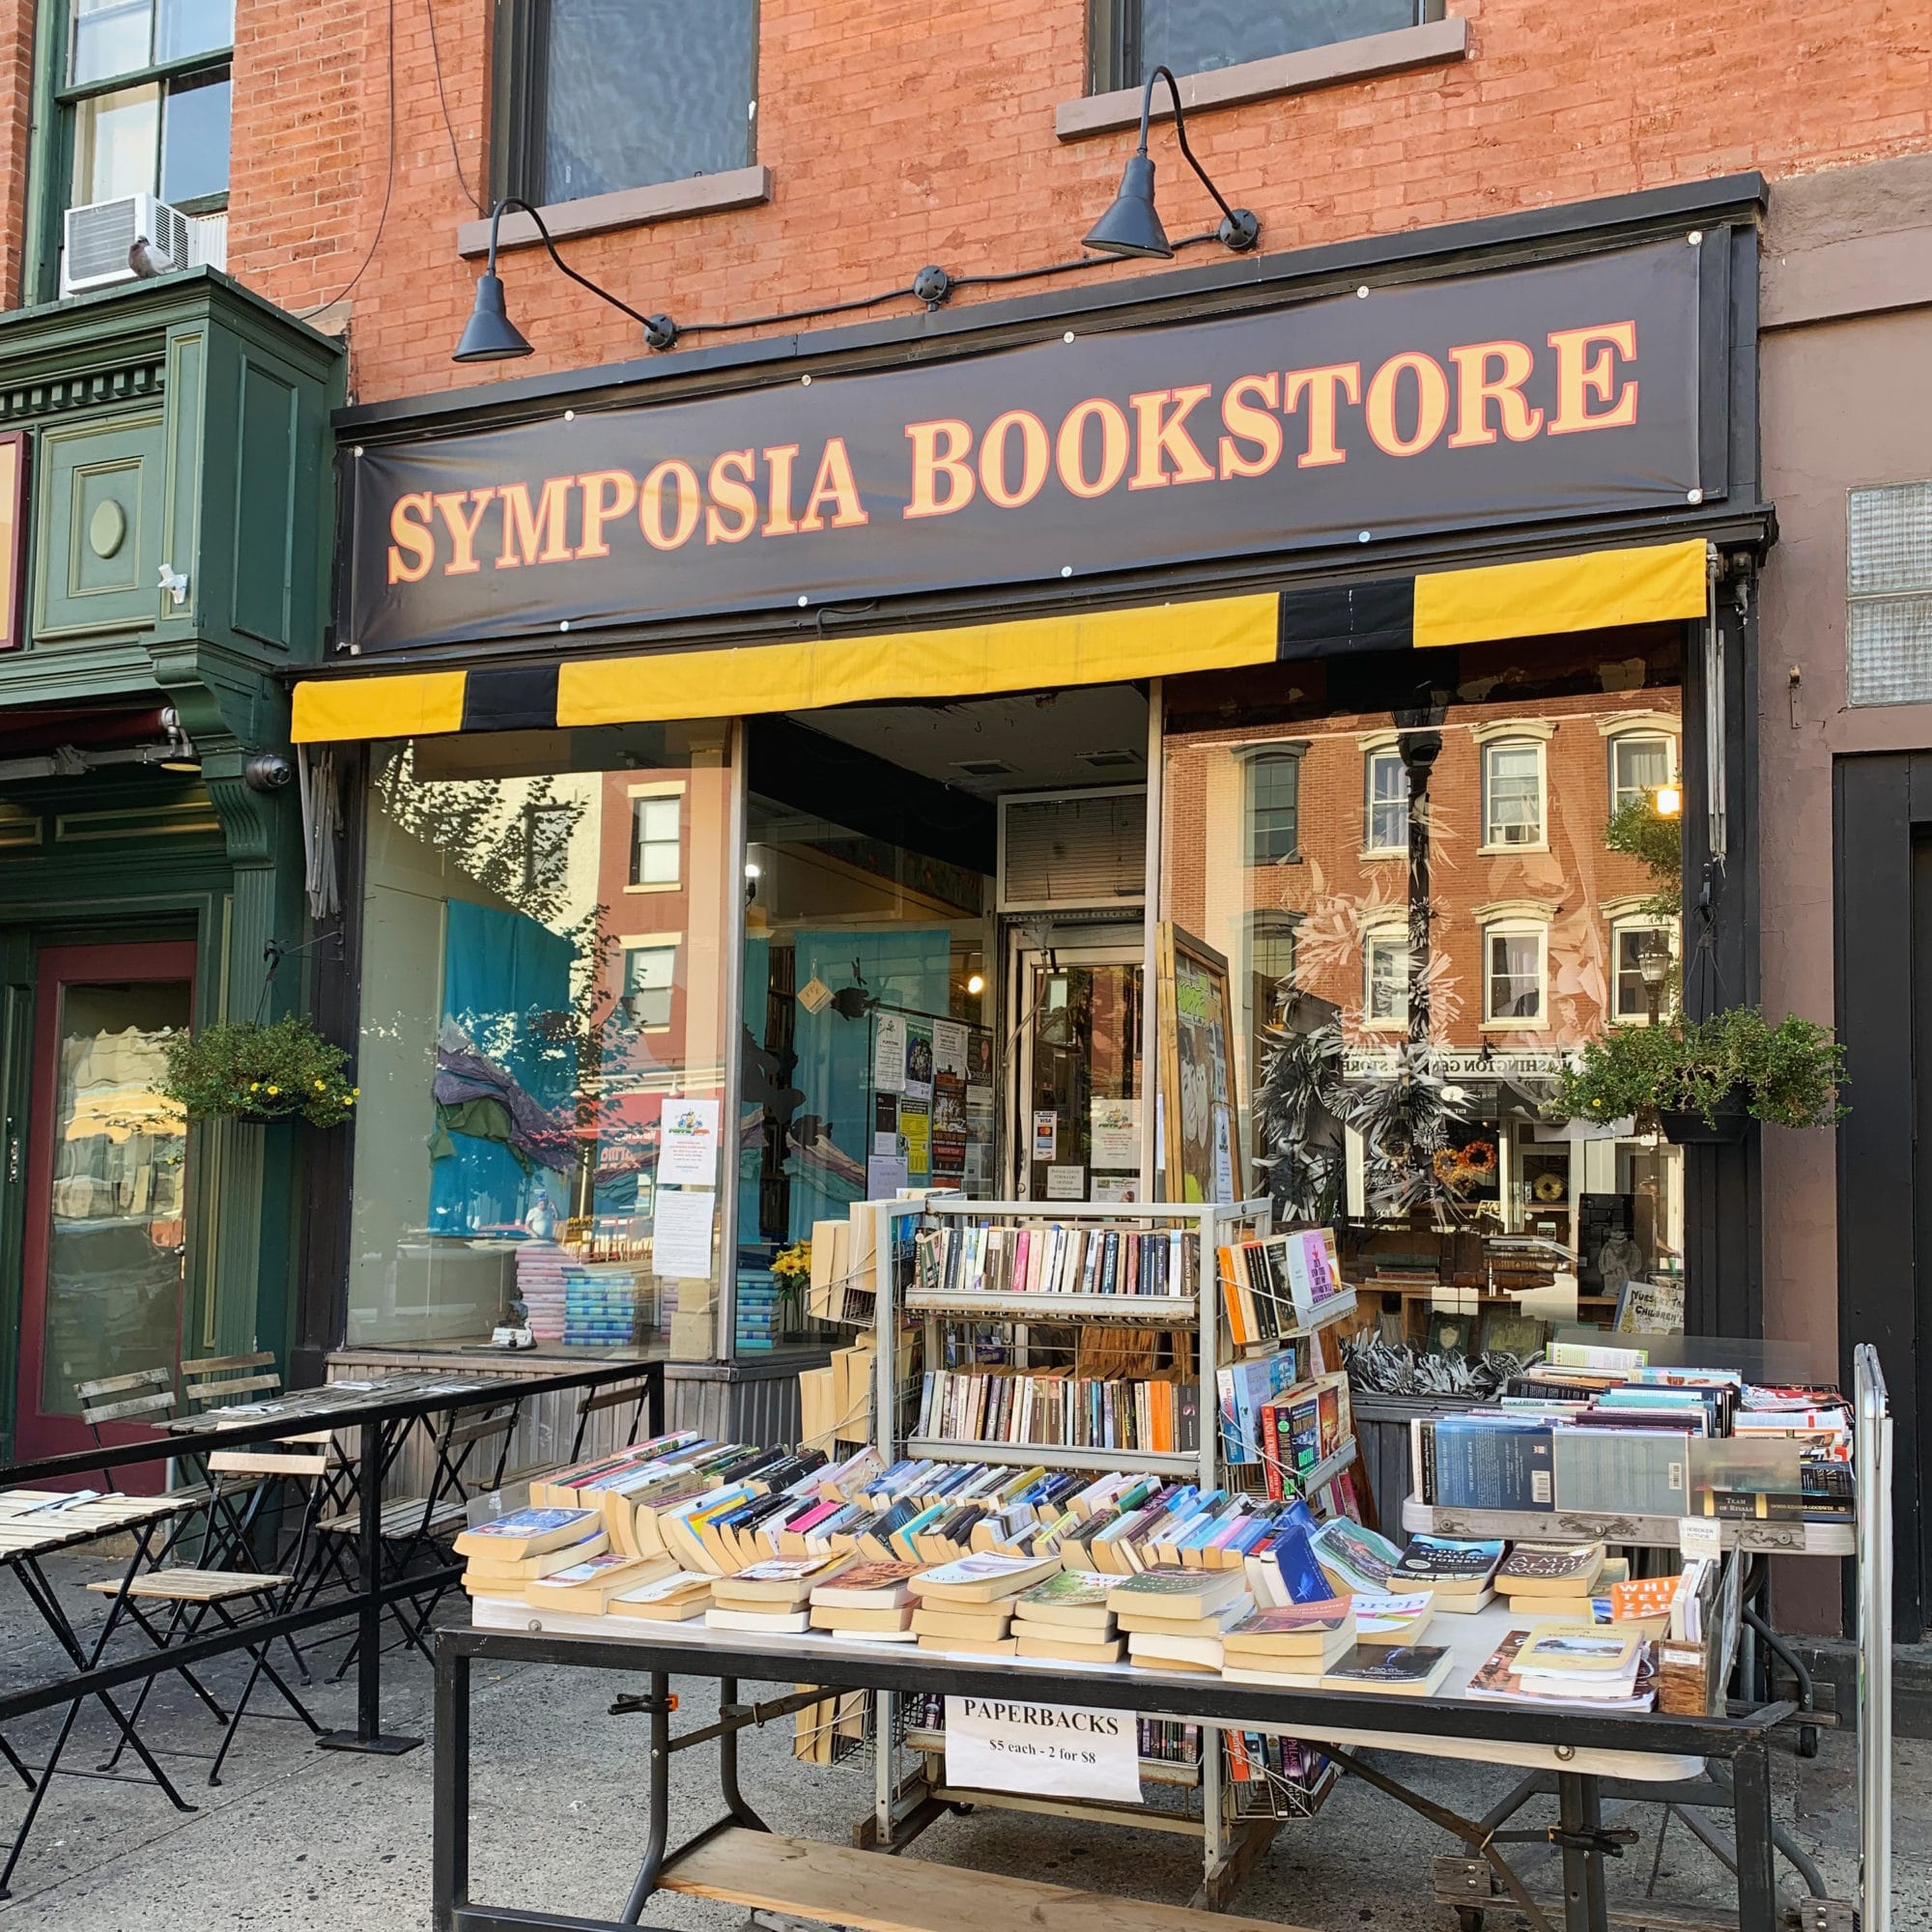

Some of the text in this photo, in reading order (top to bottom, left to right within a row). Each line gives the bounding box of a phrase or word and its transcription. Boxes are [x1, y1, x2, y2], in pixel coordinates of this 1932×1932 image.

[388, 320, 1638, 584] SYMPOSIA BOOKSTORE
[1419, 1549, 1486, 1561] STEALING
[1509, 1560, 1540, 1569] OF
[1621, 1593, 1668, 1602] TEE
[963, 1698, 1120, 1736] PAPERBACKS
[989, 1739, 1006, 1752] $5
[1008, 1741, 1037, 1756] each
[1048, 1746, 1056, 1759] 2
[1059, 1747, 1078, 1761] for
[1081, 1749, 1097, 1765] $8
